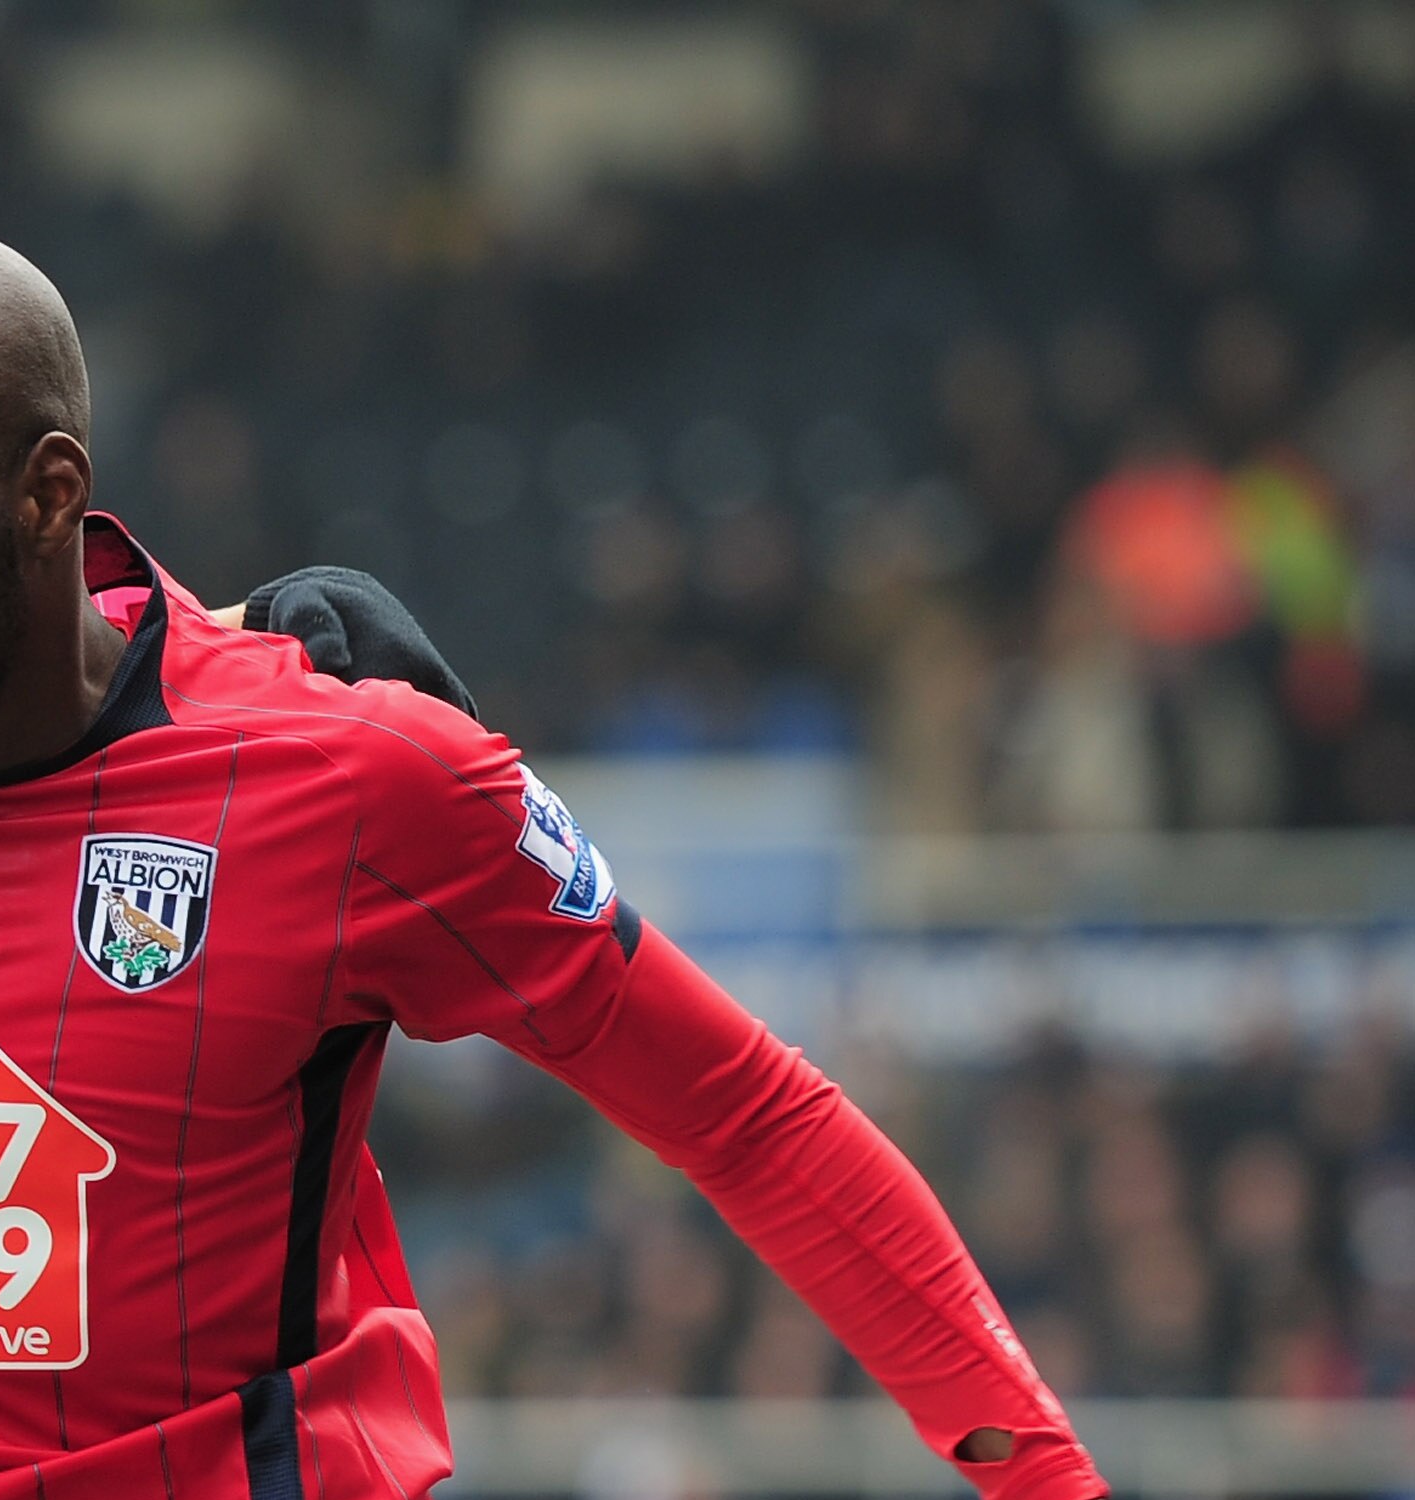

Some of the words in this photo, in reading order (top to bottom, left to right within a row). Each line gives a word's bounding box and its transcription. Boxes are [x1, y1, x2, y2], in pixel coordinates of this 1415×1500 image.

[93, 845, 130, 860] WEST
[131, 850, 205, 869] BROMWICH
[91, 858, 203, 895] ALBION
